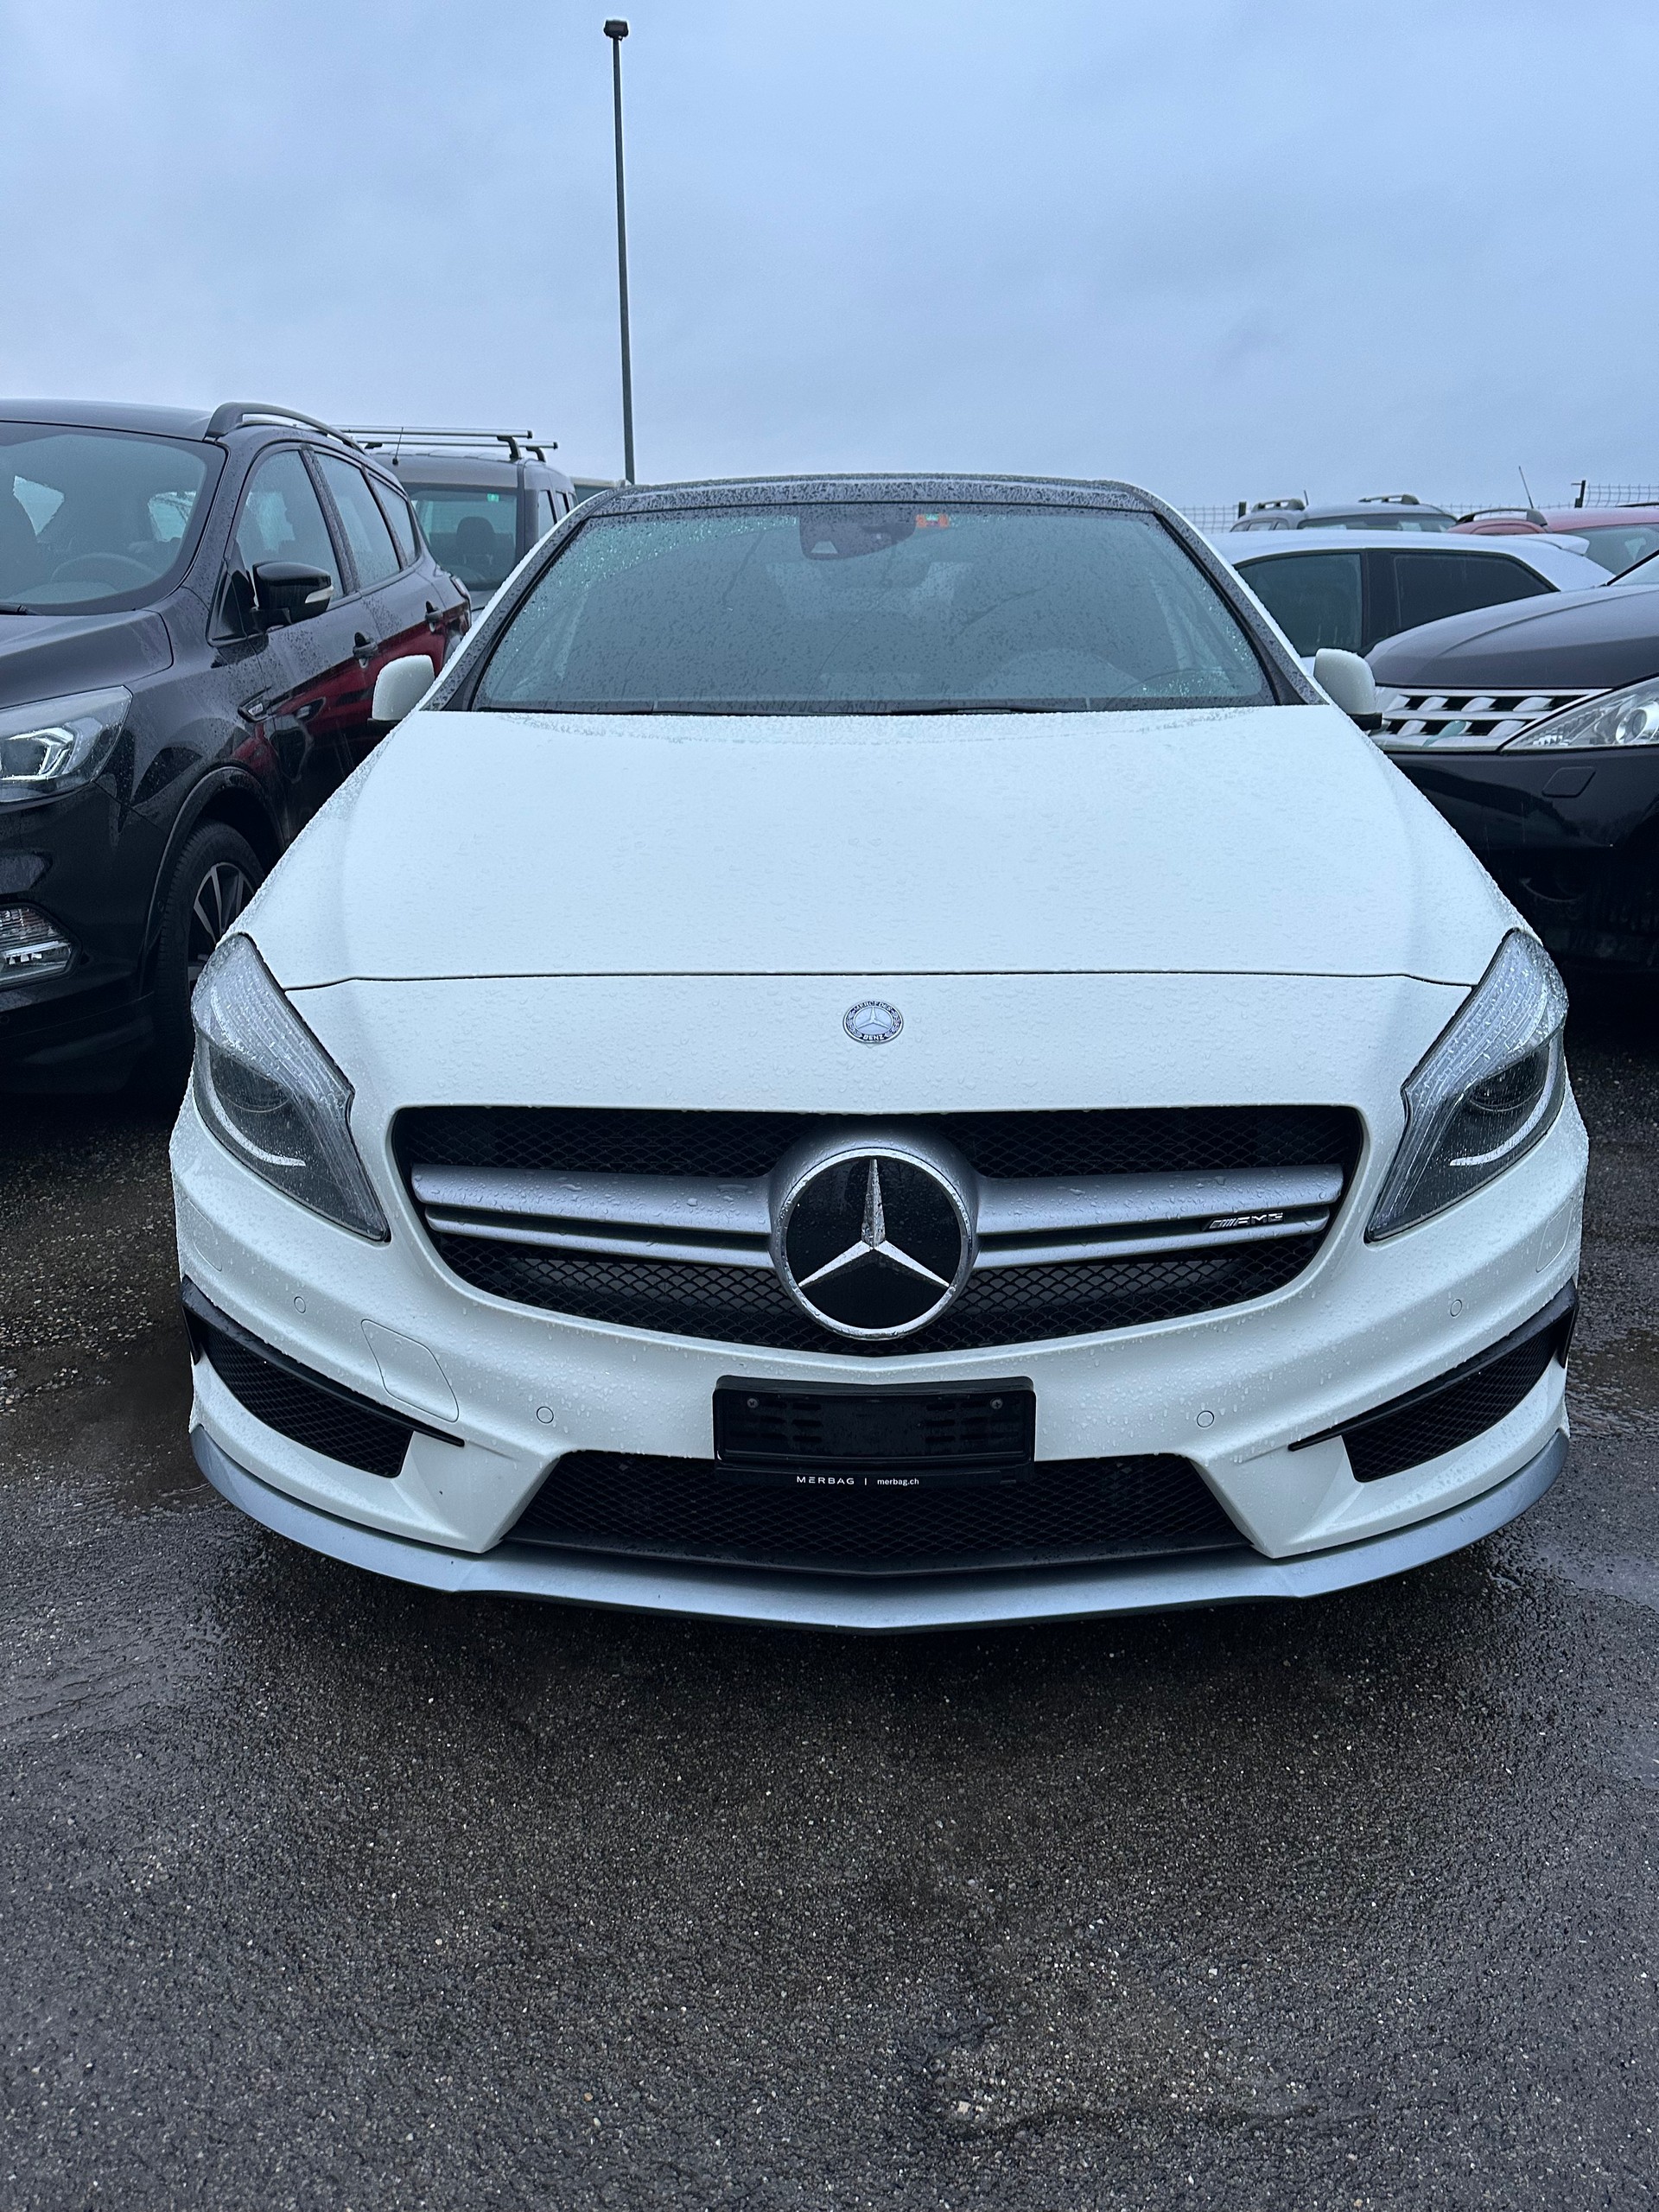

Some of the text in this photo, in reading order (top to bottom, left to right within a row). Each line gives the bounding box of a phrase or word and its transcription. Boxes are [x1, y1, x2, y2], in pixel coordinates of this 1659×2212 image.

[1233, 1212, 1284, 1226] AMG
[796, 1475, 855, 1485] MERBAG
[877, 1478, 919, 1486] merbag.ch
